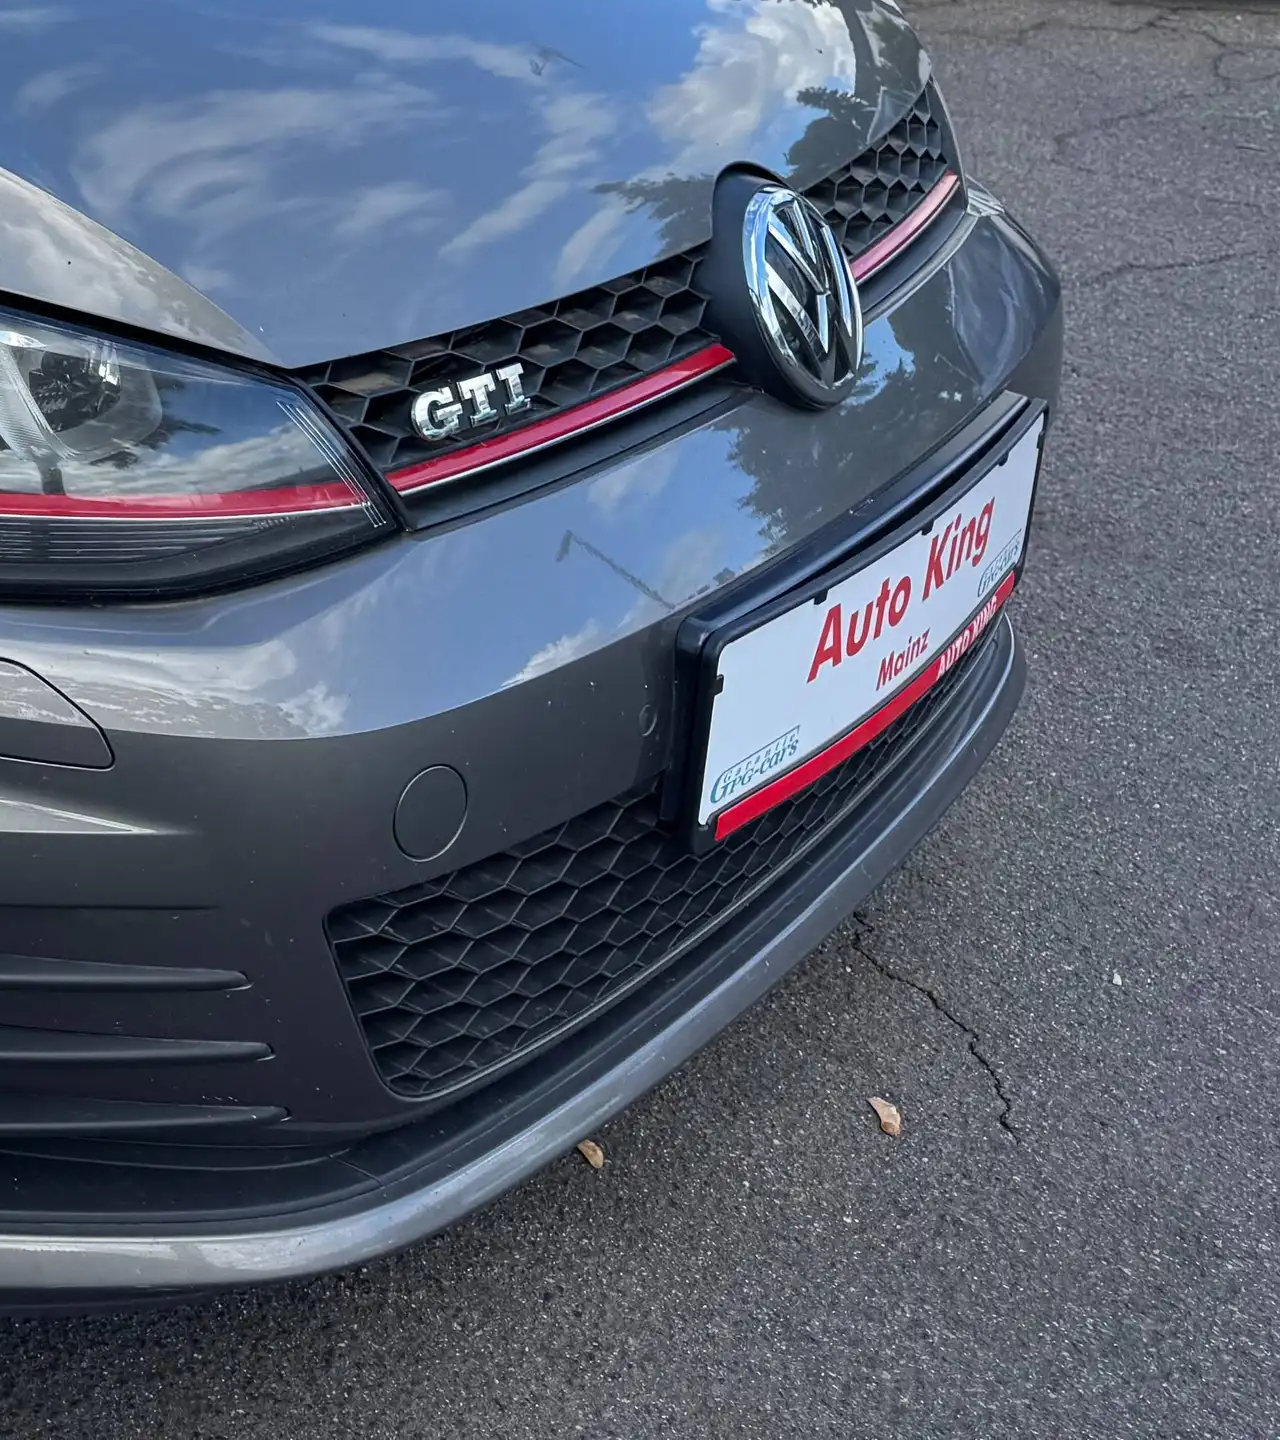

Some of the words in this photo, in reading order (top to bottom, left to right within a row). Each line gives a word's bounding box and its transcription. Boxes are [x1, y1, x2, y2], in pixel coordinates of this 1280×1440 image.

[411, 362, 532, 441] GTI
[806, 574, 913, 684] Auto
[922, 496, 996, 603] King
[875, 628, 931, 692] Mainz
[938, 627, 973, 676] AUTO
